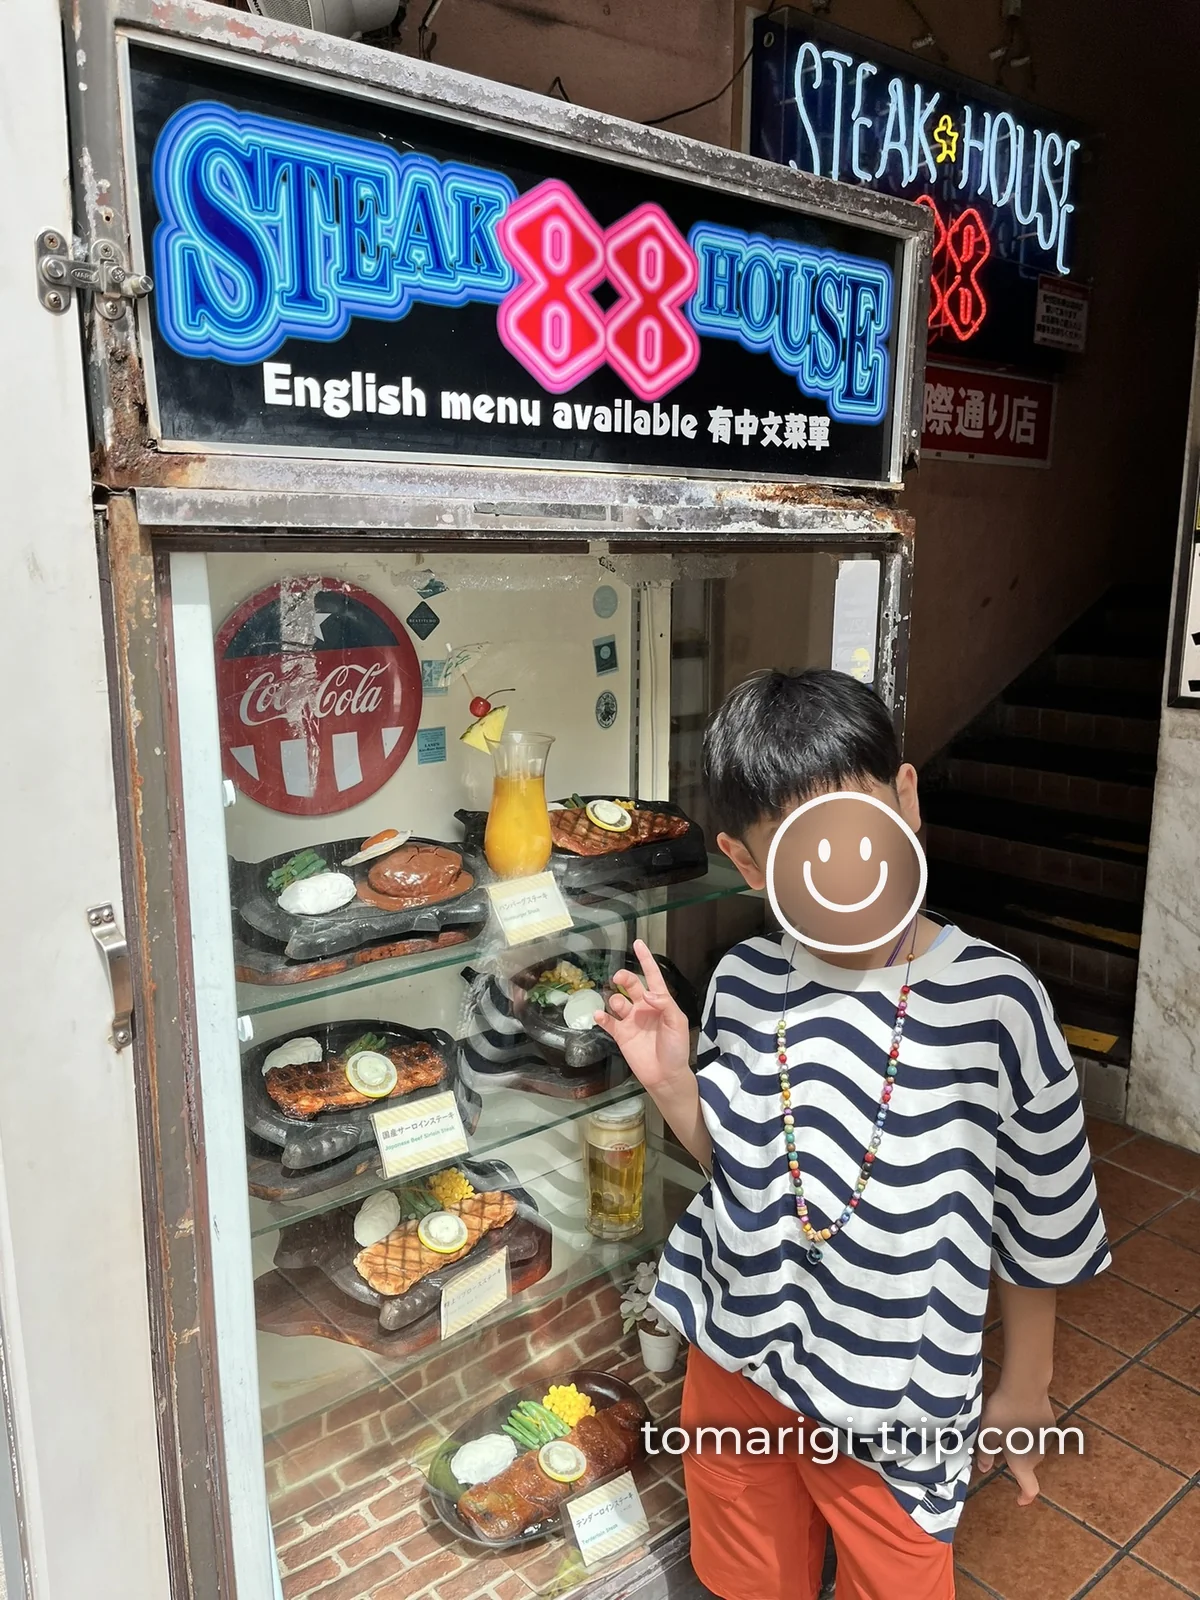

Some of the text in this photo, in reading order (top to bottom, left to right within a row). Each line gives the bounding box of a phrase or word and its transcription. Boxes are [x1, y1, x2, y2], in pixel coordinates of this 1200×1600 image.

[788, 41, 1081, 274] STEAK HOUSE
[166, 112, 889, 415] STEAK 88 HOUSE
[263, 361, 831, 450] English menu available 有中文菜單
[921, 382, 1039, 445] 際通り店
[382, 1112, 455, 1140] 国産サーロインステーキ
[385, 1125, 456, 1151] Japanese Beef Sirloin Steak
[576, 1491, 634, 1528] テンダーロインステーキ
